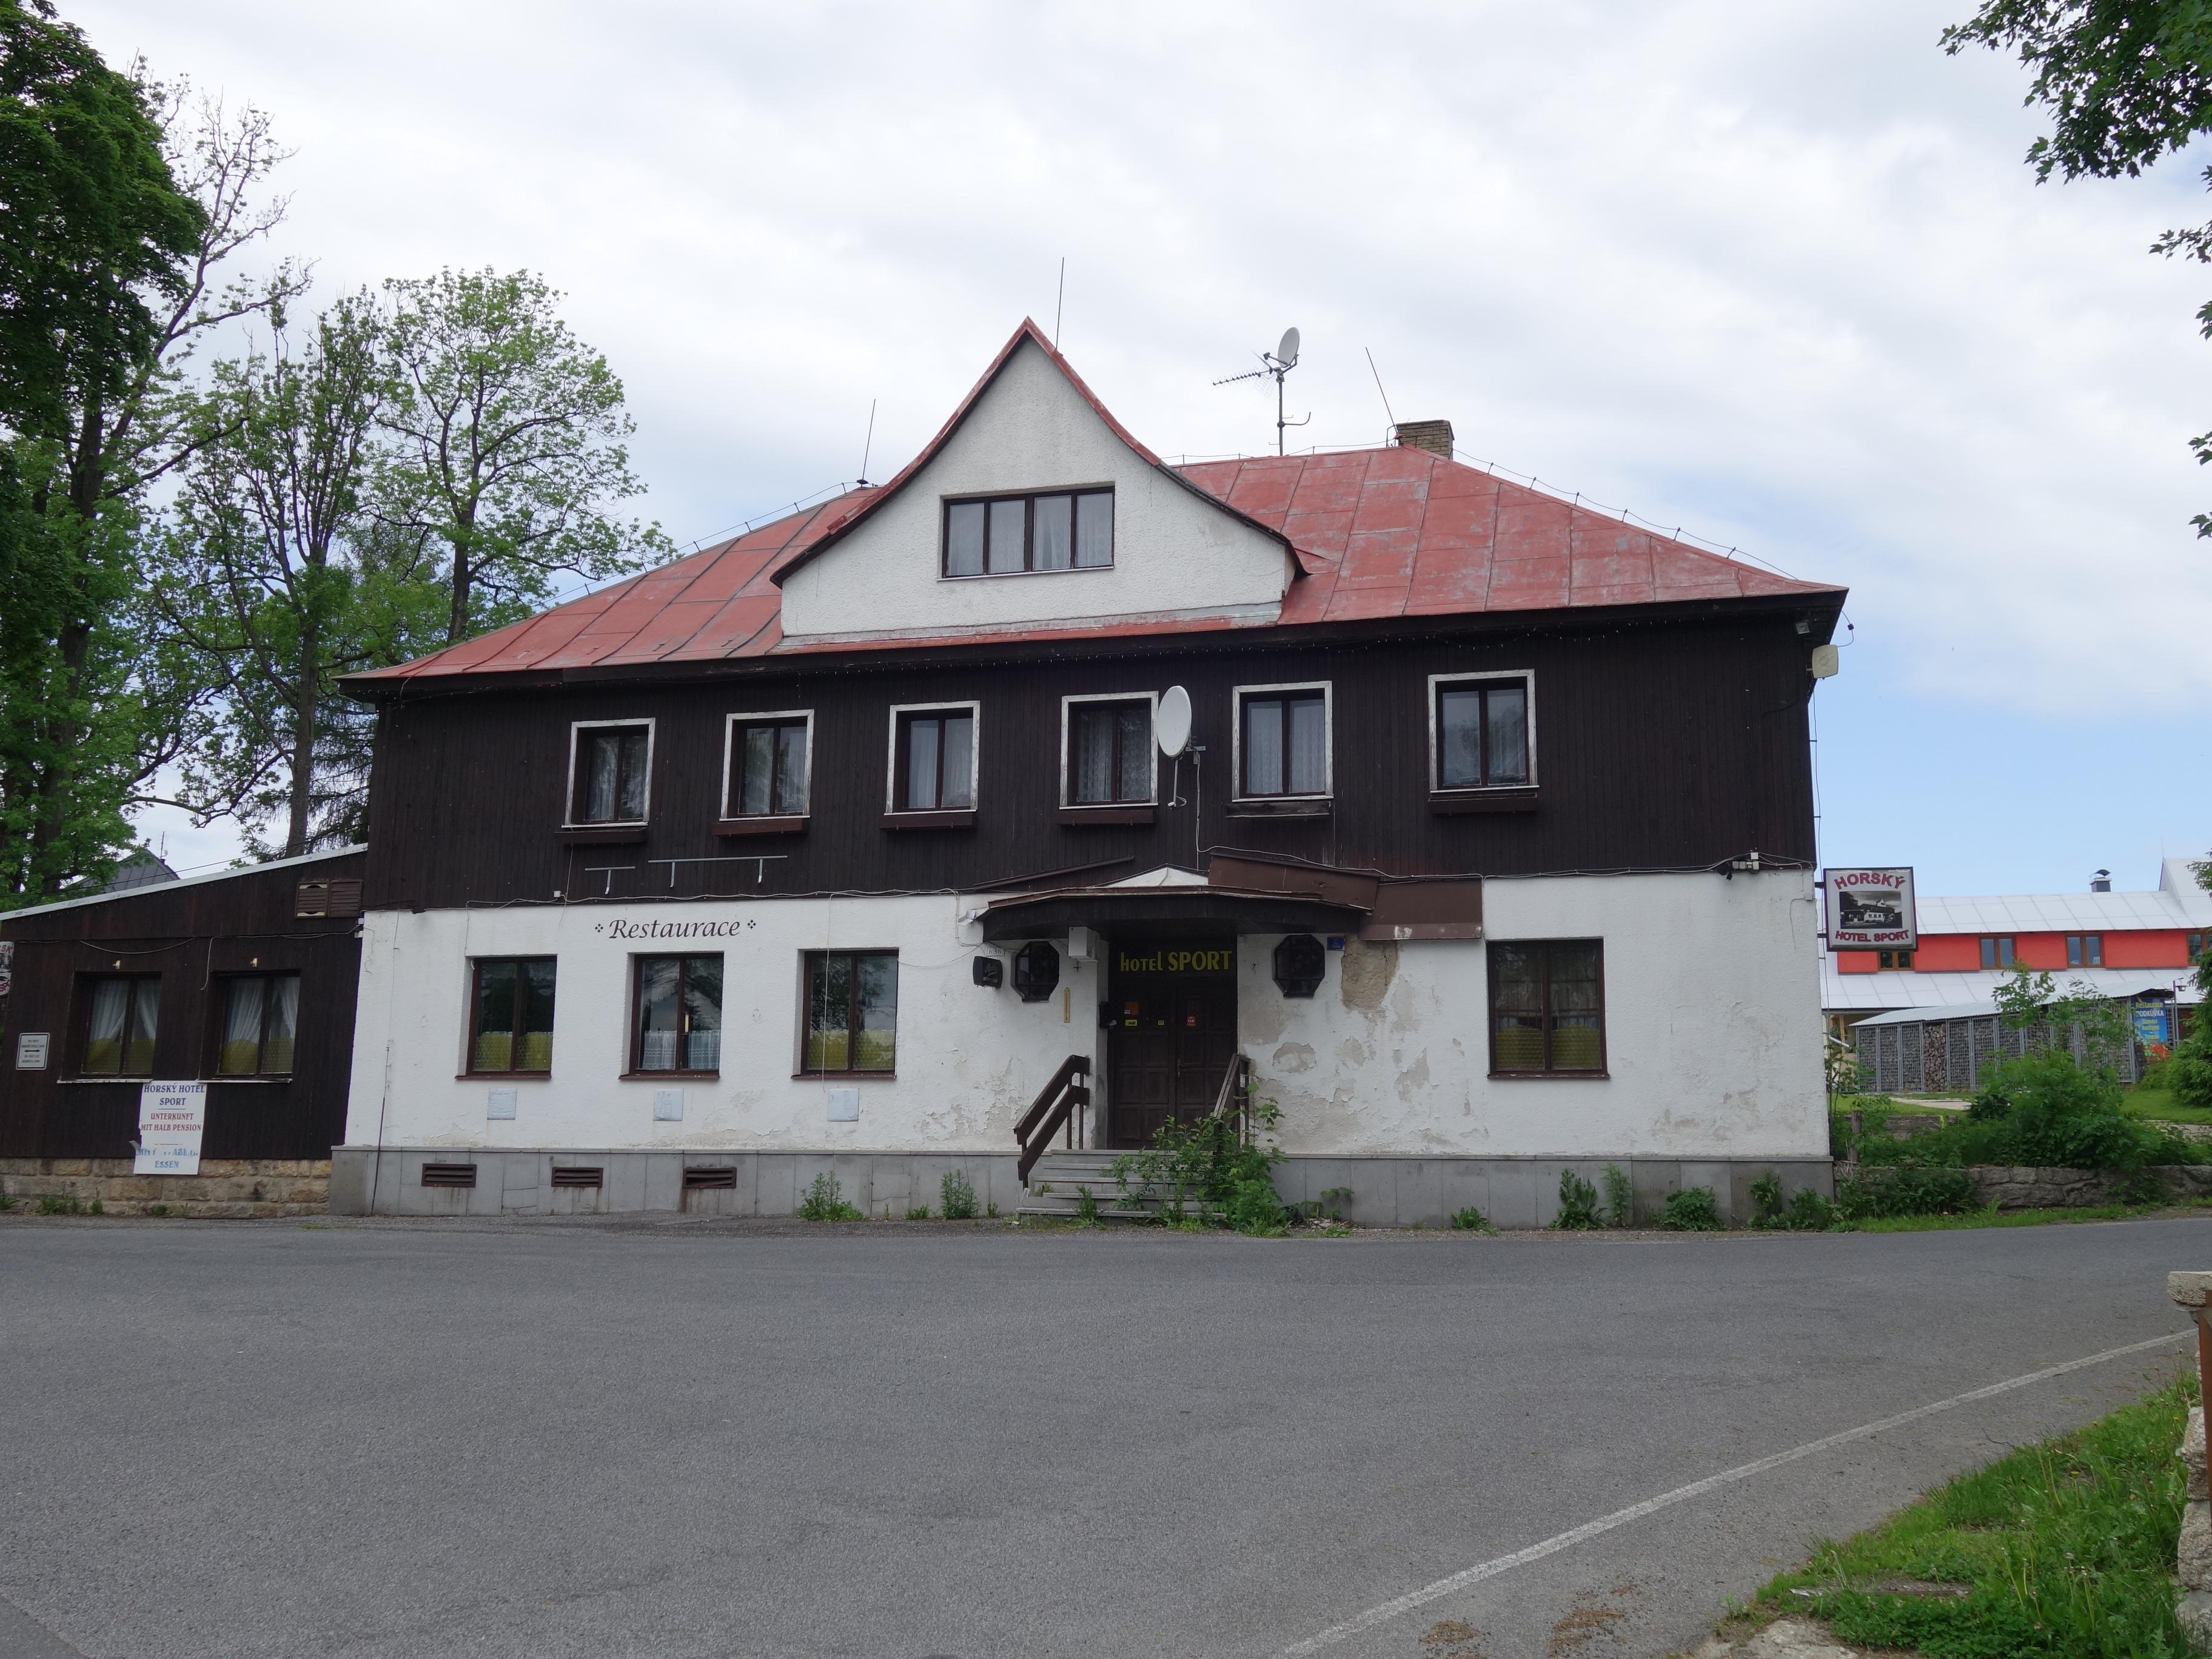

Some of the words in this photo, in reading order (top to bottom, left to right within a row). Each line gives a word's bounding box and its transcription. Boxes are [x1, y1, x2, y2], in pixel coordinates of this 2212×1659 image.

[1834, 873, 1906, 890] HORSKÝ
[609, 919, 740, 939] Restaurace
[1835, 930, 1871, 942] HOTEL
[1874, 930, 1909, 942] SPORT
[1168, 951, 1232, 971] SPORT
[159, 1098, 186, 1106] SPORT
